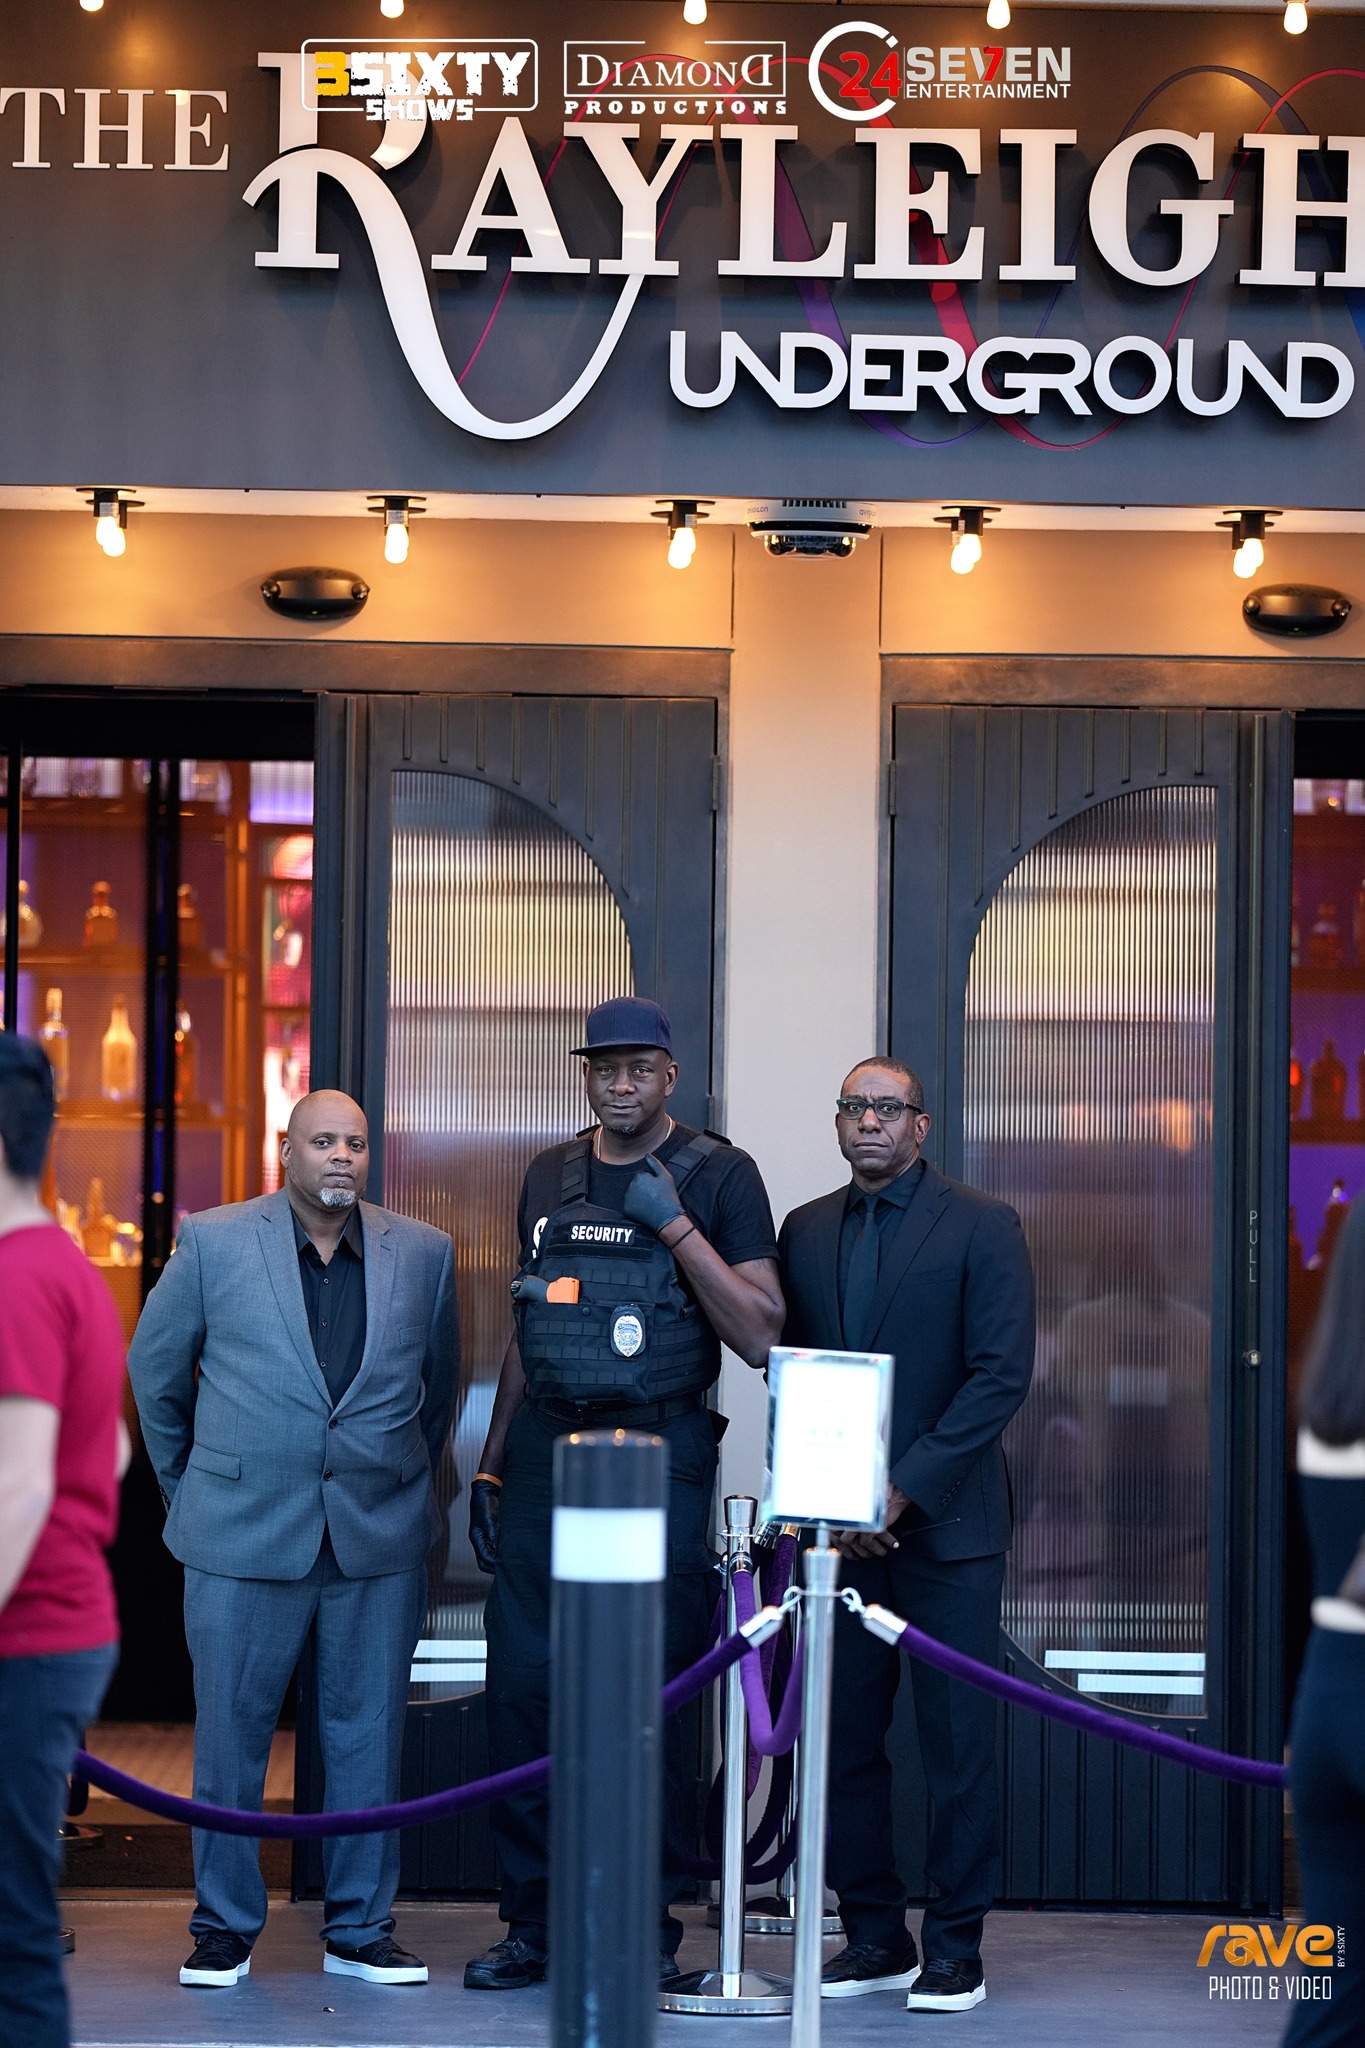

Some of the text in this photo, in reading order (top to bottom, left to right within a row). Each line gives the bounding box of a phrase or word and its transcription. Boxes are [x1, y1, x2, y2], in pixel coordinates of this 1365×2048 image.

[0, 52, 1365, 439] THE RAYLEIGH
[669, 329, 1355, 418] UNDERGROUND
[570, 1225, 633, 1244] SECURITY
[1249, 1210, 1258, 1283] PULL
